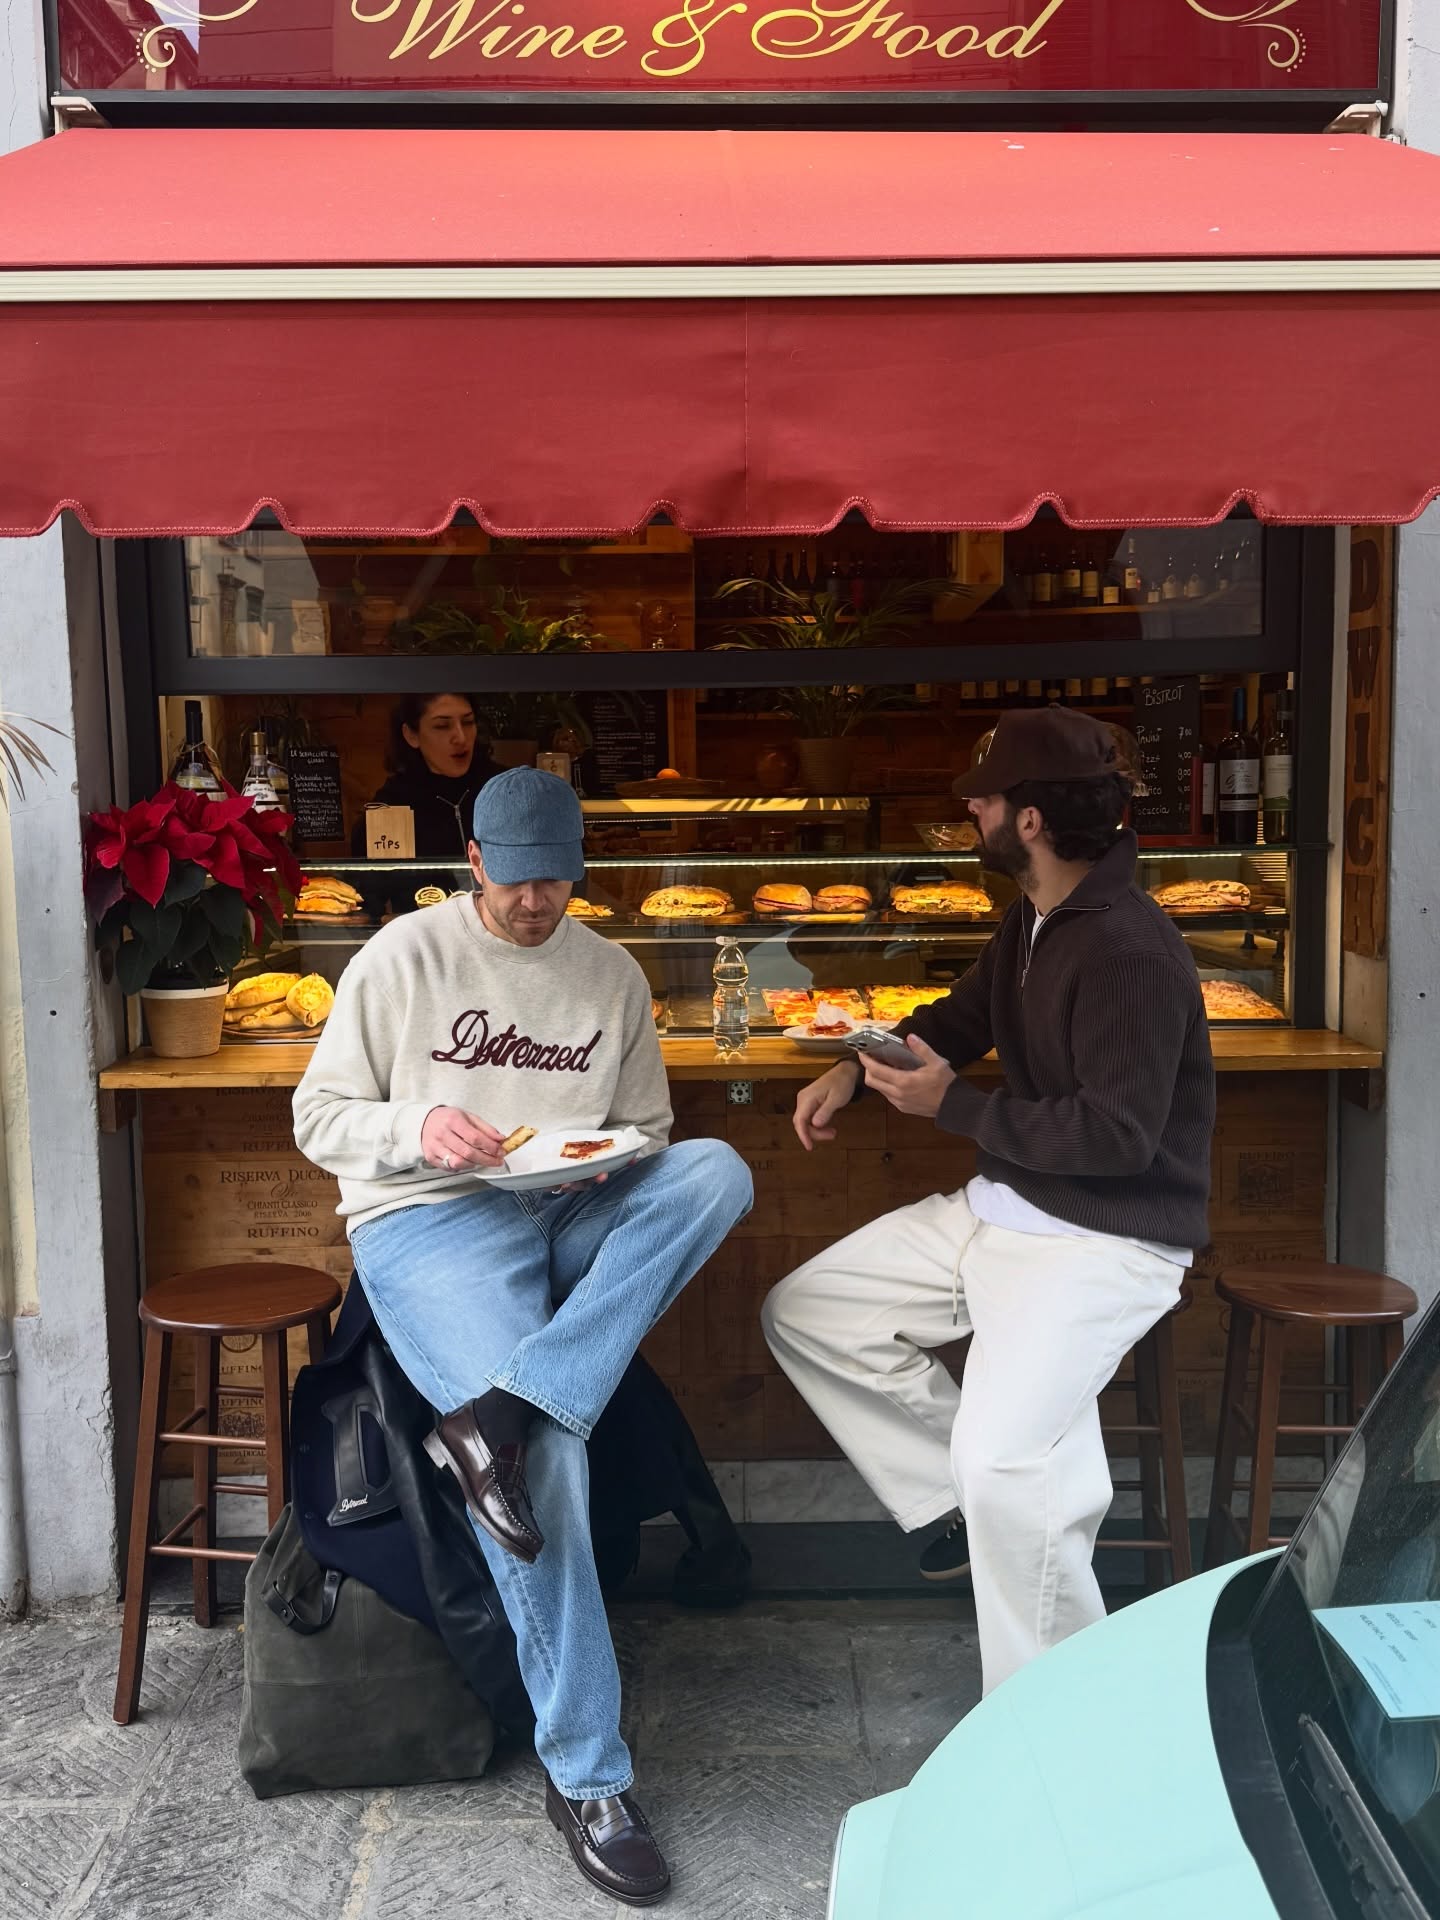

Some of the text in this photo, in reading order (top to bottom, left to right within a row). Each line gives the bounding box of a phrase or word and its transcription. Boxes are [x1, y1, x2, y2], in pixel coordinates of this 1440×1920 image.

[352, 0, 1064, 77] Wine & Food
[243, 1140, 296, 1153] RUFFI
[220, 1168, 338, 1184] RISERVA DUCAL
[247, 1199, 318, 1210] CHIANTI CLASSICO
[247, 1226, 319, 1239] RUFFINO
